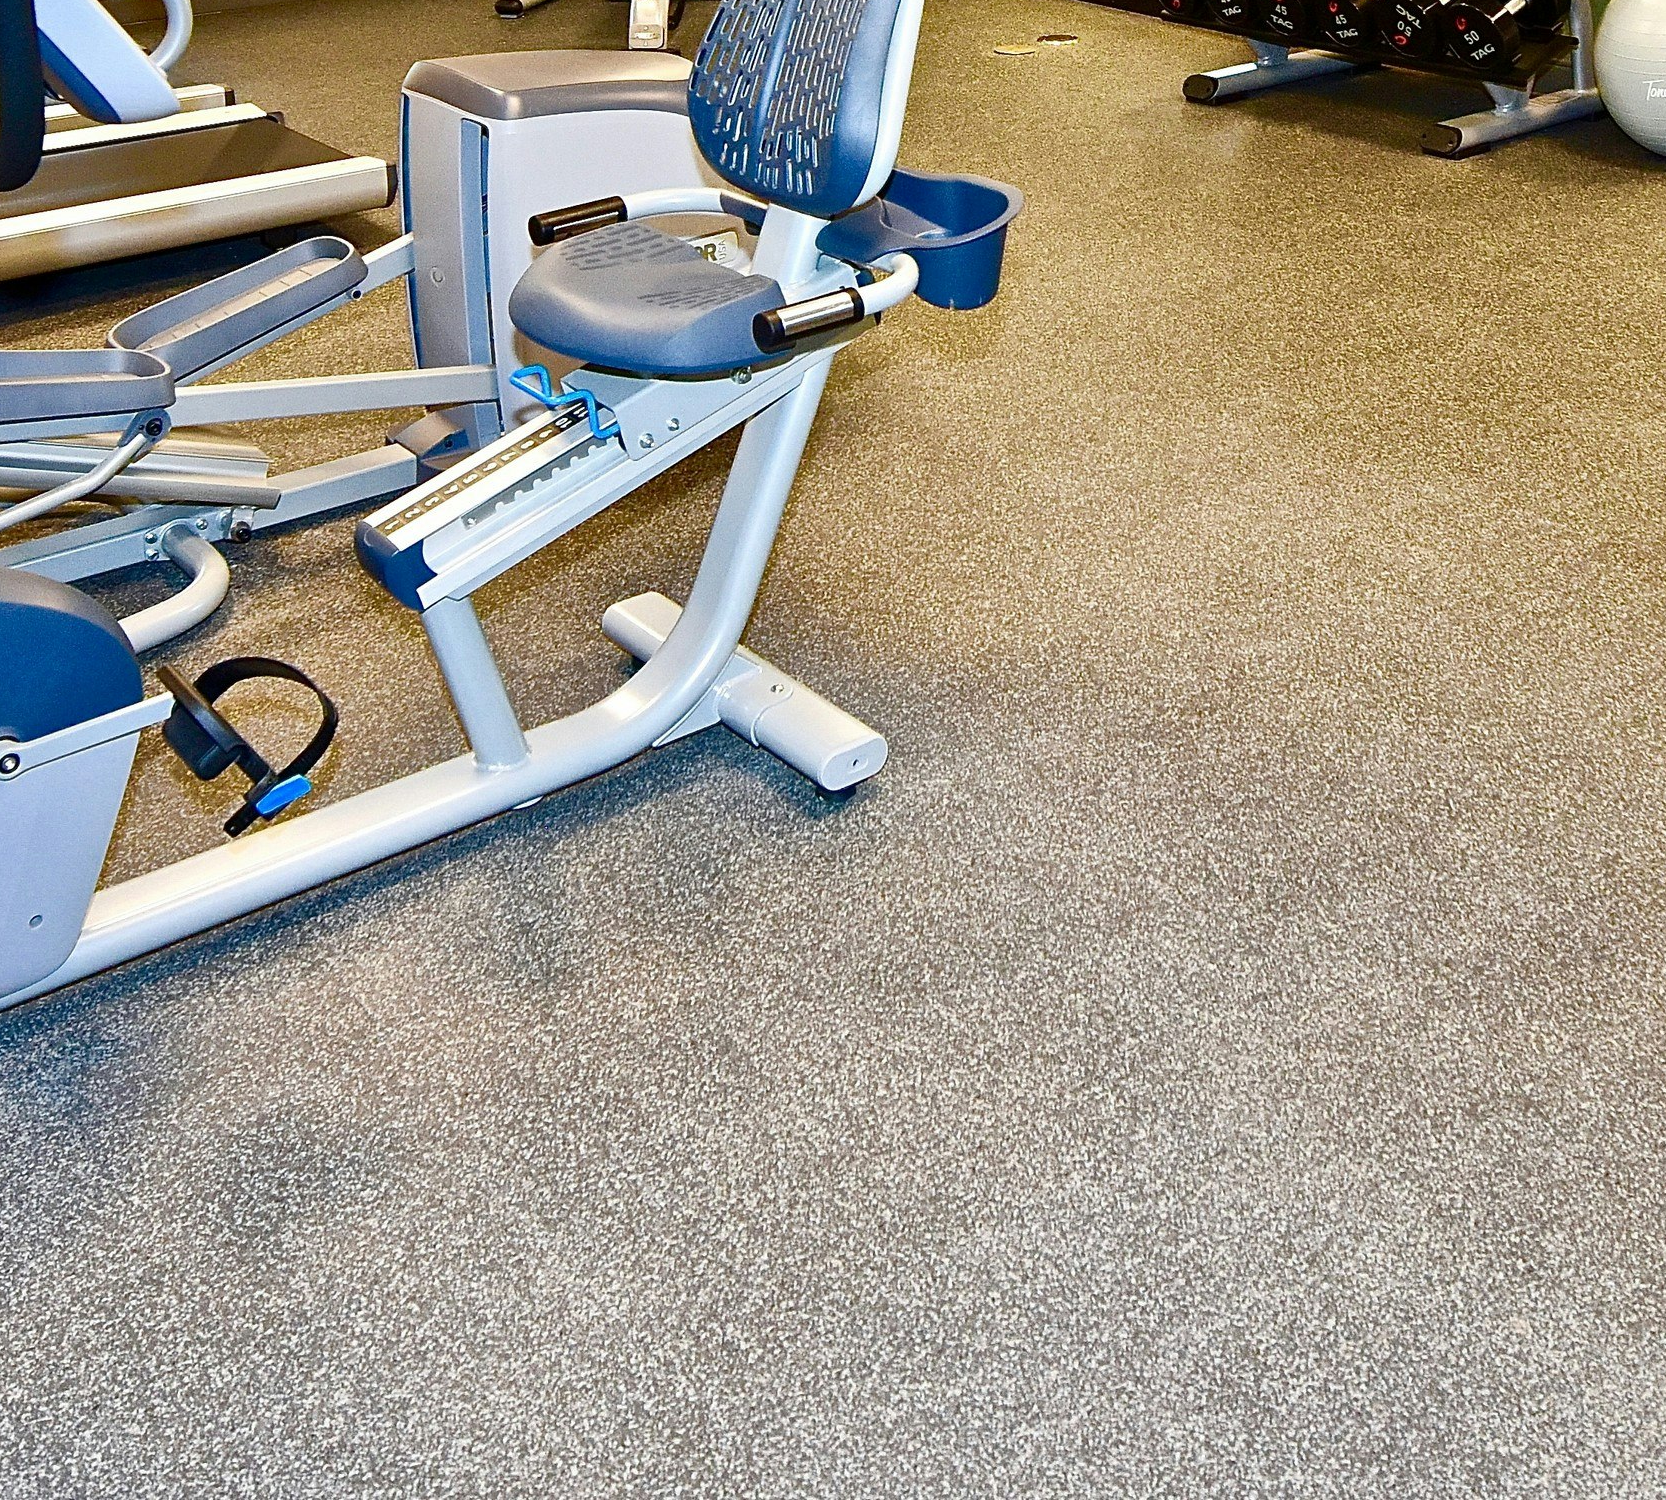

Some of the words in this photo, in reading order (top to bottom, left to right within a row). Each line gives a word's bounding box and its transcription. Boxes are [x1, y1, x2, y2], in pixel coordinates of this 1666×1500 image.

[1221, 5, 1242, 17] TAG
[1275, 4, 1288, 16] 45
[1395, 4, 1422, 29] TAG
[1270, 14, 1294, 30] TAG
[1335, 14, 1348, 25] 45
[1336, 28, 1359, 39] TAG
[1397, 20, 1412, 38] 50
[1463, 30, 1480, 45] 50
[1470, 43, 1496, 61] TAG
